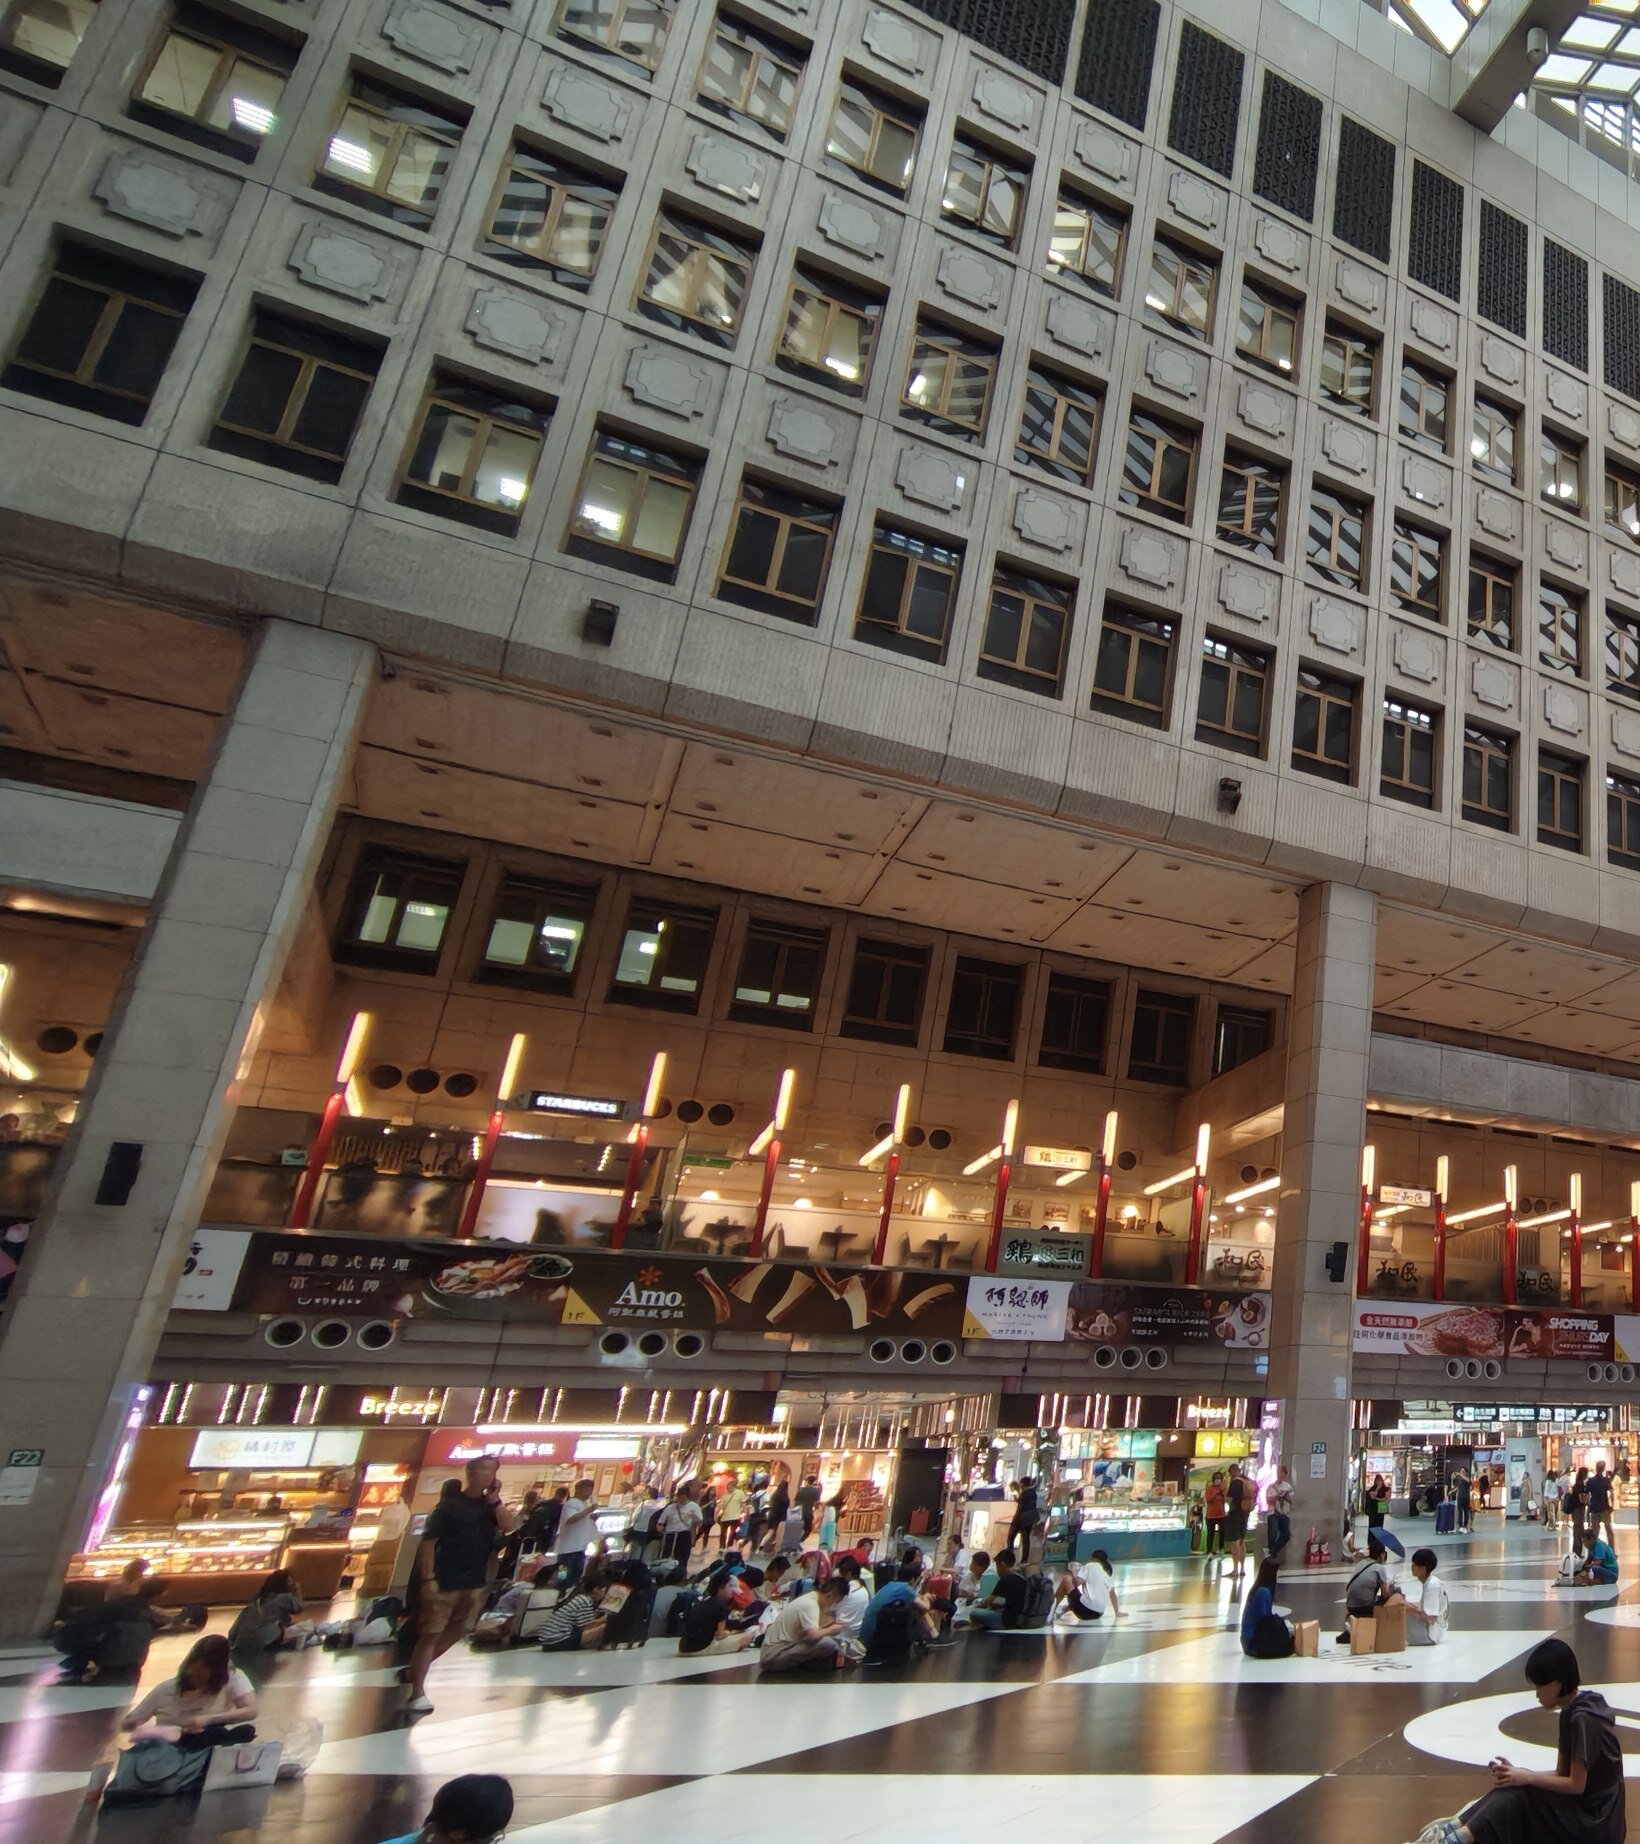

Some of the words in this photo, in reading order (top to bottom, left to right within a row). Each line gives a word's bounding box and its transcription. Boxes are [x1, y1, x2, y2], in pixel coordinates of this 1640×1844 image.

[536, 1096, 617, 1114] STARBUCKS
[614, 1281, 683, 1307] Amo
[567, 1312, 585, 1321] 1F
[1549, 1317, 1599, 1331] SHOPPING
[360, 1395, 440, 1416] Breeze
